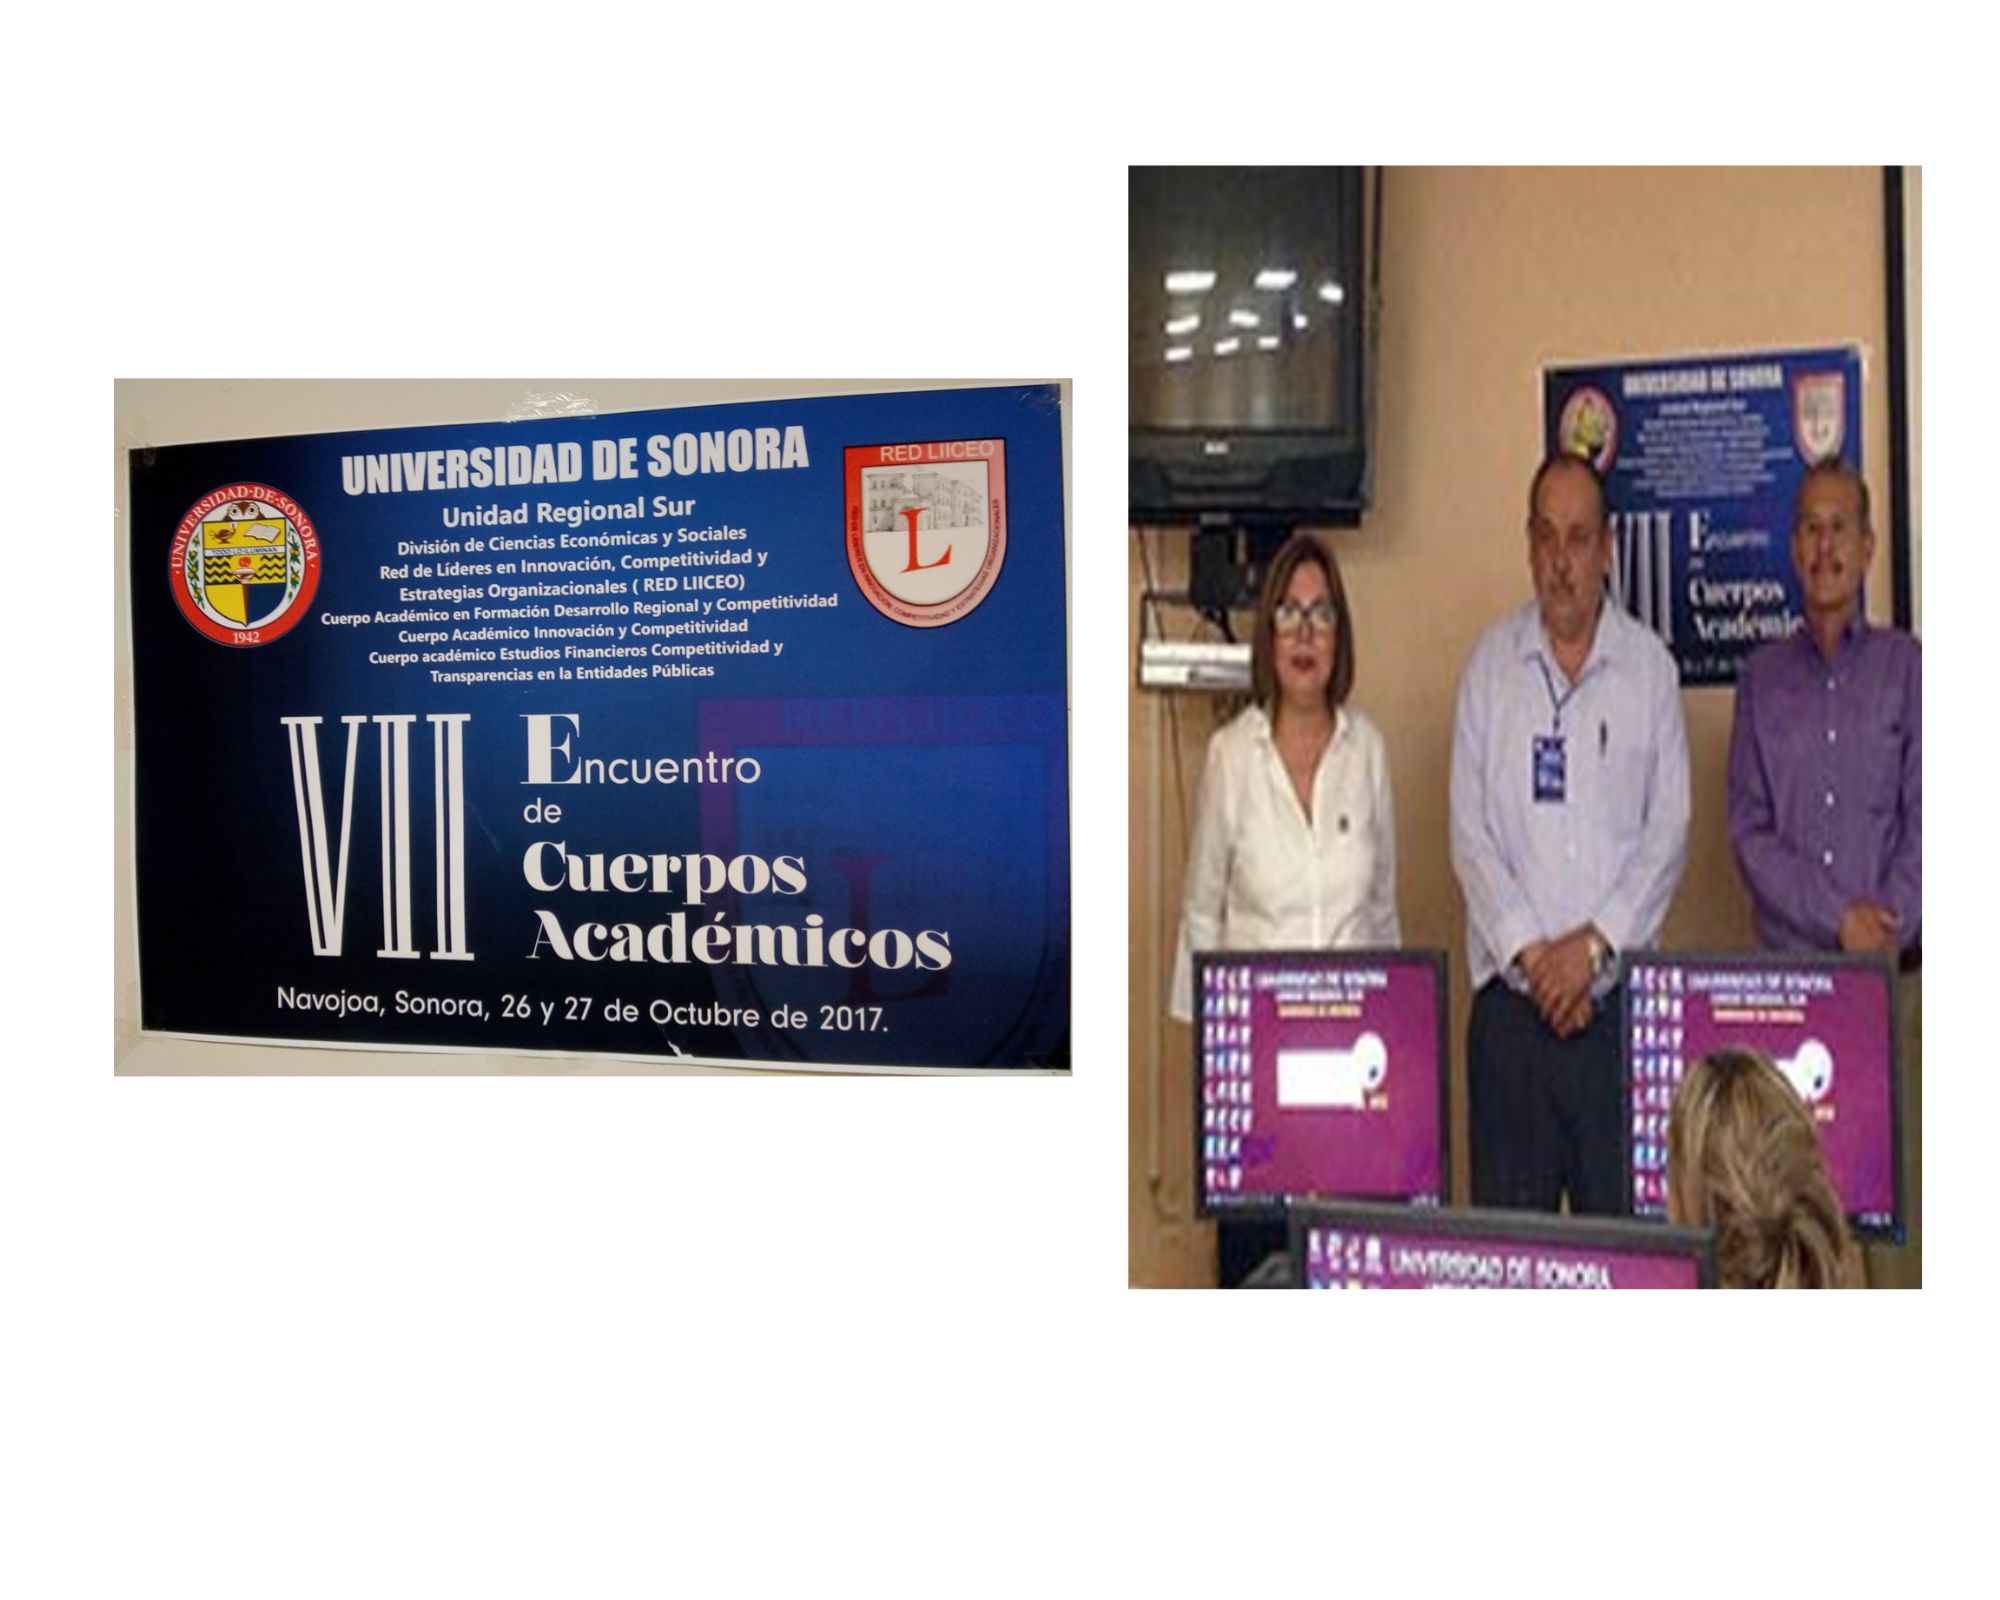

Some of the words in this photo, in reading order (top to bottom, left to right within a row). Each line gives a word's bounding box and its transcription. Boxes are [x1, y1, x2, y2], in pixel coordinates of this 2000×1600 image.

[341, 440, 583, 495] UNIVERSIDAD
[593, 438, 638, 480] DE
[647, 426, 809, 477] SONORA
[880, 444, 922, 463] RED
[928, 440, 995, 459] LIICEO
[172, 486, 249, 568] UNIVERSIDAD
[253, 486, 276, 502] DE
[277, 497, 319, 561] SONORA
[444, 503, 527, 527] Unidad
[538, 497, 644, 527] Regional
[653, 496, 695, 517] Sur
[399, 539, 459, 555] División
[465, 538, 484, 552] de
[489, 535, 555, 550] Ciencias
[561, 531, 657, 547] Económicas
[663, 533, 672, 547] y
[678, 526, 746, 542] Sociales
[899, 506, 953, 573] L
[381, 565, 408, 579] Red
[413, 564, 432, 577] de
[437, 562, 492, 576] Líderes
[497, 564, 516, 574] en
[522, 556, 616, 574] Innovación,
[621, 550, 752, 571] Competitividad
[758, 552, 767, 566] y
[400, 585, 483, 603] Estrategias
[488, 580, 627, 600] Organizacionales
[644, 577, 677, 592] RED
[684, 575, 745, 590] LIICEO)
[322, 613, 370, 627] Cuerpo
[375, 609, 449, 622] Académico
[453, 611, 469, 621] en
[475, 605, 549, 619] Formación
[555, 602, 629, 616] Desarrollo
[634, 599, 698, 617] Regional
[703, 602, 712, 615] y
[717, 594, 837, 613] Competitividad
[234, 632, 260, 644] 1942
[399, 631, 448, 645] Cuerpo
[453, 627, 529, 640] Académico
[535, 624, 614, 638] Innovación
[619, 627, 627, 639] y
[632, 619, 748, 637] Competitividad
[370, 652, 418, 666] Cuerpo
[423, 649, 495, 662] académico
[501, 647, 560, 660] Estudios
[565, 645, 647, 658] Financieros
[652, 640, 769, 658] Competitividad
[774, 643, 783, 656] y
[431, 668, 533, 685] Transparencias
[538, 671, 555, 681] en
[560, 667, 572, 679] la
[577, 665, 647, 679] Entidades
[653, 664, 714, 677] Públicas
[520, 713, 761, 785] Encuentro
[524, 798, 561, 824] de
[281, 714, 474, 960] VII
[524, 841, 807, 905] Cuerpos
[527, 911, 952, 971] Académicos
[277, 987, 385, 1018] Navojoa,
[396, 991, 490, 1020] Sonora,
[502, 995, 531, 1017] 26
[541, 1003, 555, 1026] y
[566, 997, 592, 1020] 27
[605, 999, 639, 1023] de
[650, 1000, 760, 1027] Octubre
[771, 1005, 808, 1029] de
[821, 1006, 889, 1032] 2017.
